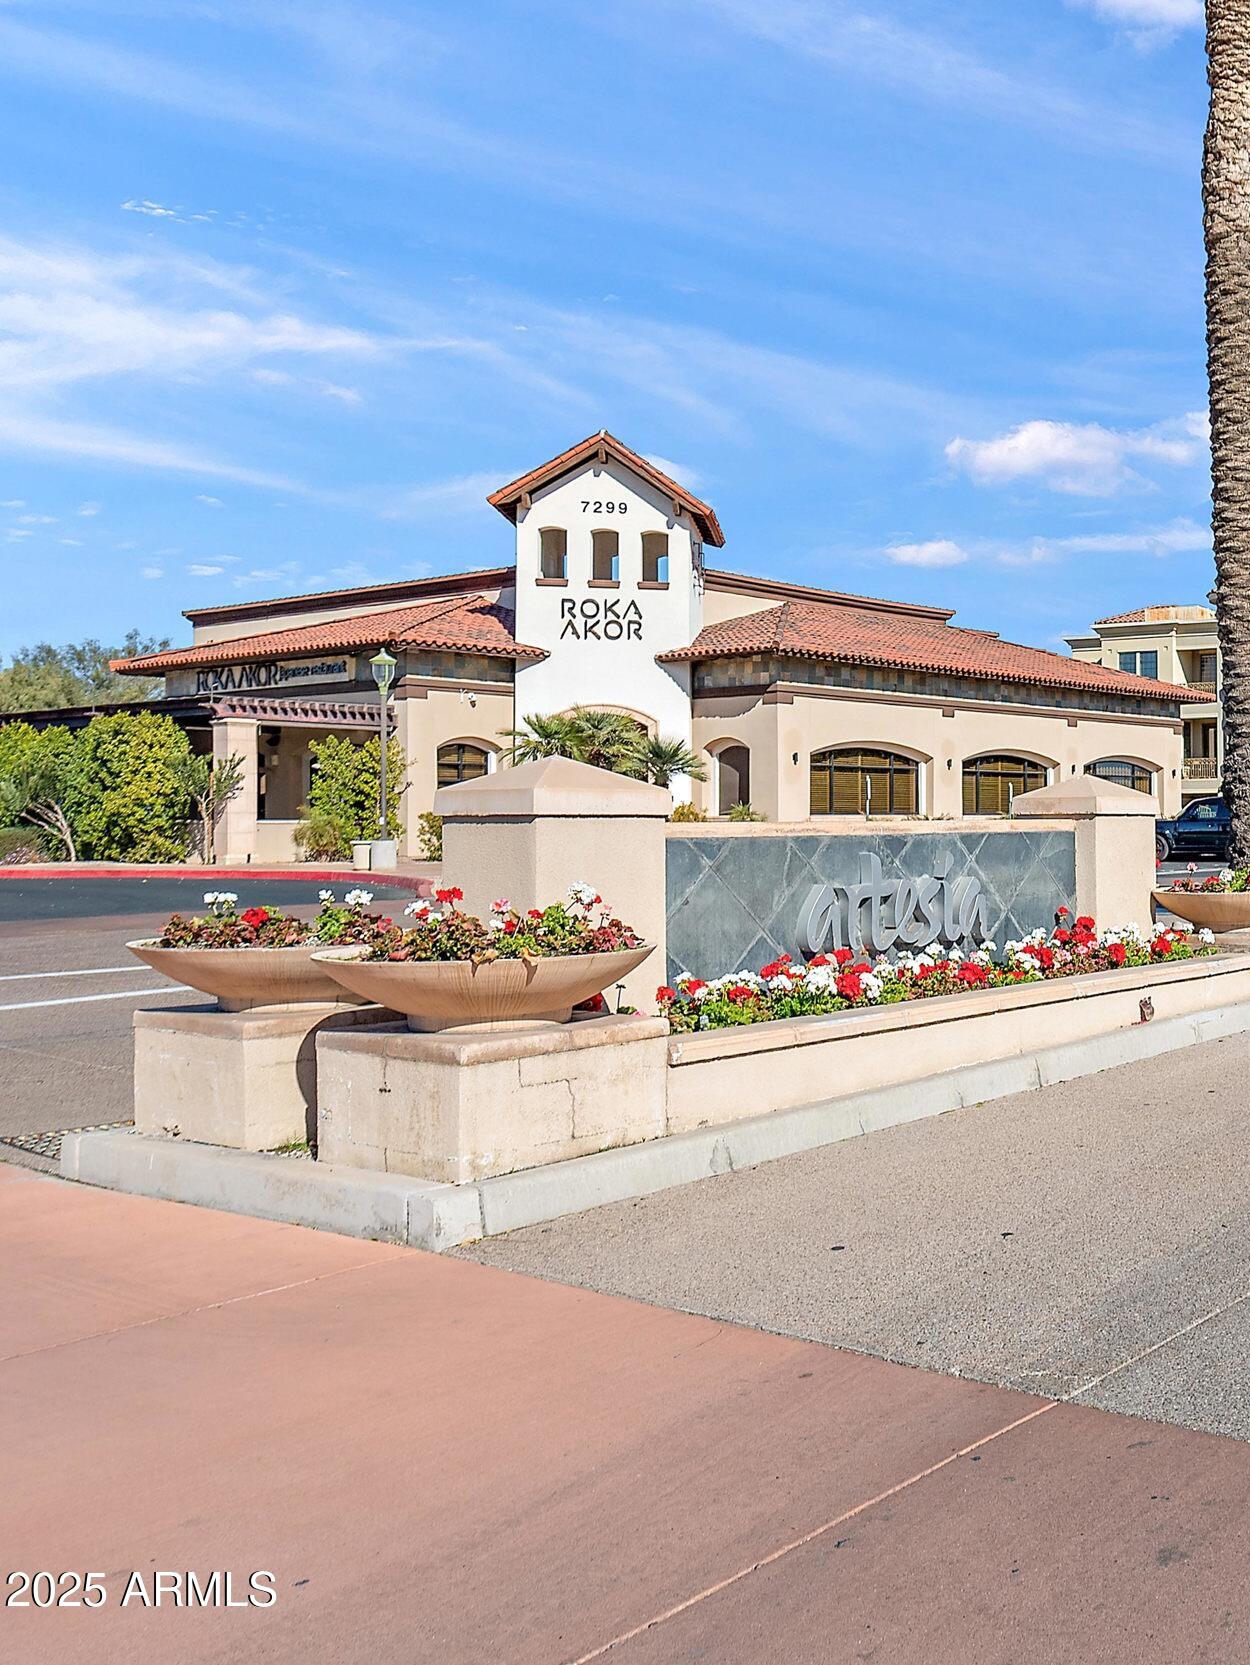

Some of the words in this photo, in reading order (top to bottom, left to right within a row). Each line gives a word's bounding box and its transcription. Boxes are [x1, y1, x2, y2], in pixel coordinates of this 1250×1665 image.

[581, 501, 628, 514] 7299
[561, 598, 643, 619] ROKA
[560, 619, 643, 641] AKOR
[196, 668, 236, 693] ROKA
[237, 663, 278, 688] AKOR
[797, 852, 988, 952] artesia
